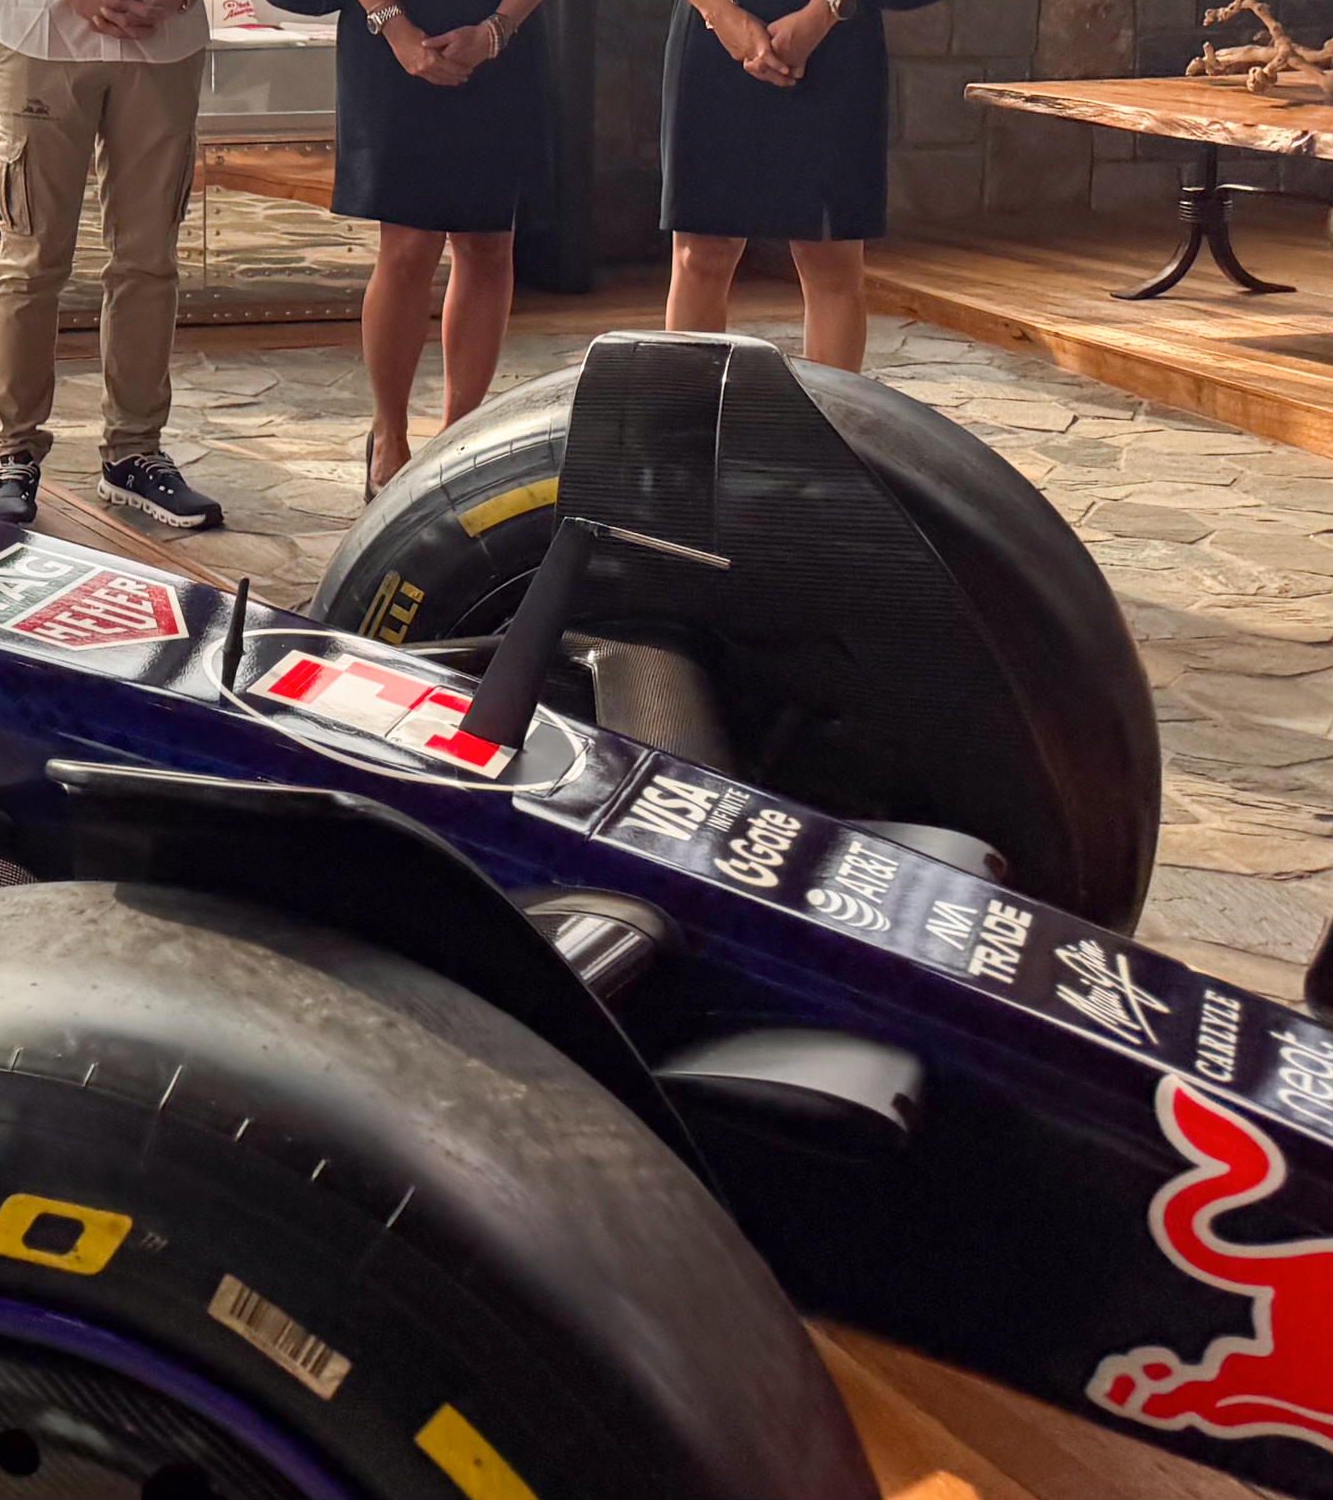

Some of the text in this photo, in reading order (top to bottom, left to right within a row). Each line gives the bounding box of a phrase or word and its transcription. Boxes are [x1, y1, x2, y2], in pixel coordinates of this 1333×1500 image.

[34, 575, 155, 642] HEUER
[617, 774, 720, 842] VISA
[705, 787, 751, 833] INFINITE
[834, 840, 900, 904] AT&T
[925, 900, 978, 951] AVA
[967, 899, 1033, 984] TRADE
[1195, 989, 1241, 1082] CARLYLE
